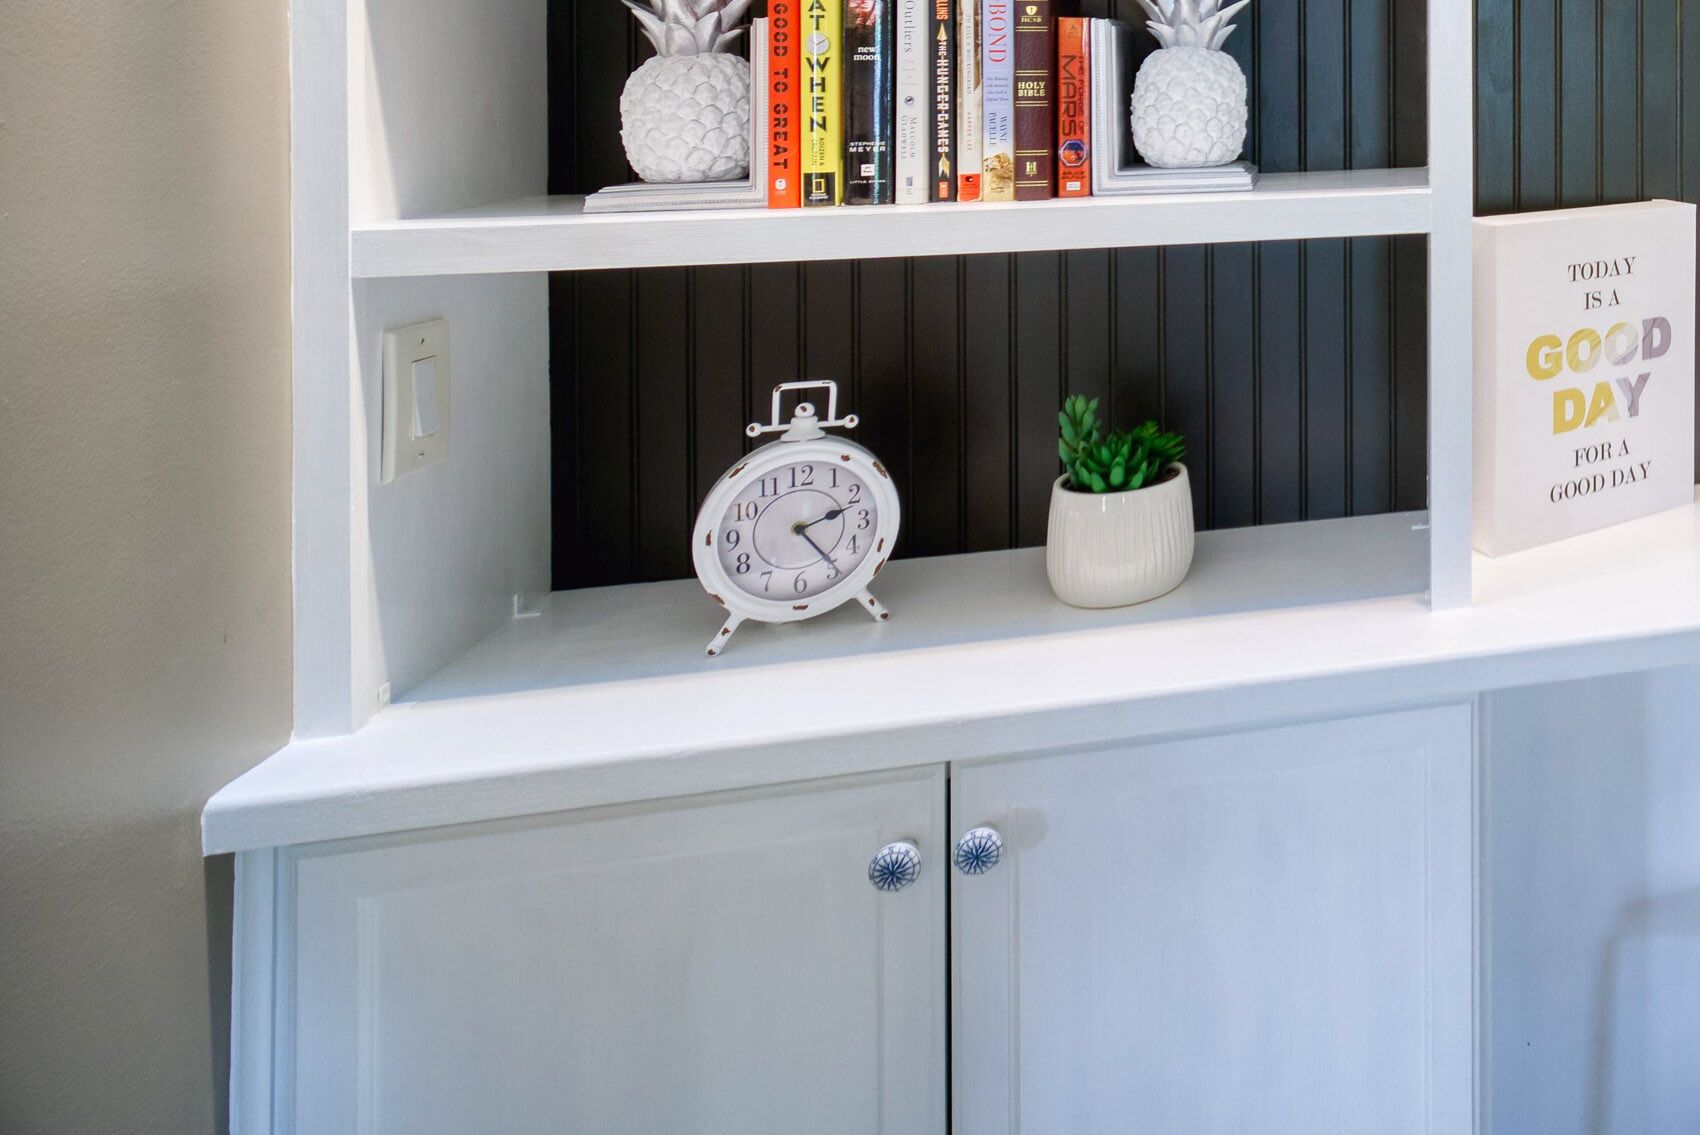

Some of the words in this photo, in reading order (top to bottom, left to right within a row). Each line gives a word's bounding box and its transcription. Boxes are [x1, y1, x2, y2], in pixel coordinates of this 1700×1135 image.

[773, 3, 788, 57] GOOD
[904, 0, 916, 53] Outliers
[988, 3, 1007, 63] BOND
[853, 53, 881, 61] moon
[938, 39, 948, 56] THE
[773, 68, 789, 93] TO
[936, 59, 949, 110] HUNGER
[1017, 81, 1046, 90] HOLY
[805, 57, 831, 132] WHEN
[1017, 89, 1046, 97] BIBLE
[1061, 54, 1078, 137] MARS
[773, 103, 789, 170] GREAT
[937, 113, 949, 154] GAMES
[1000, 115, 1009, 144] WAYNE
[1567, 255, 1637, 283] TODAY
[1583, 291, 1603, 311] IS
[1608, 288, 1622, 307] A
[1525, 316, 1673, 382] GOOD
[1552, 371, 1652, 436] DAY
[1573, 441, 1614, 468] FOR
[1617, 438, 1631, 457] A
[758, 476, 781, 499] 11
[787, 464, 815, 488] 12
[828, 467, 841, 489] 1
[1549, 473, 1606, 505] GOOD
[1610, 460, 1653, 490] DAY
[847, 483, 862, 505] 2
[734, 500, 758, 522] 10
[857, 508, 870, 530] 3
[725, 529, 741, 553] 9
[845, 534, 860, 554] 4
[735, 552, 751, 575] 8
[826, 558, 841, 581] 5
[759, 570, 774, 593] 7
[792, 569, 808, 594] 6
